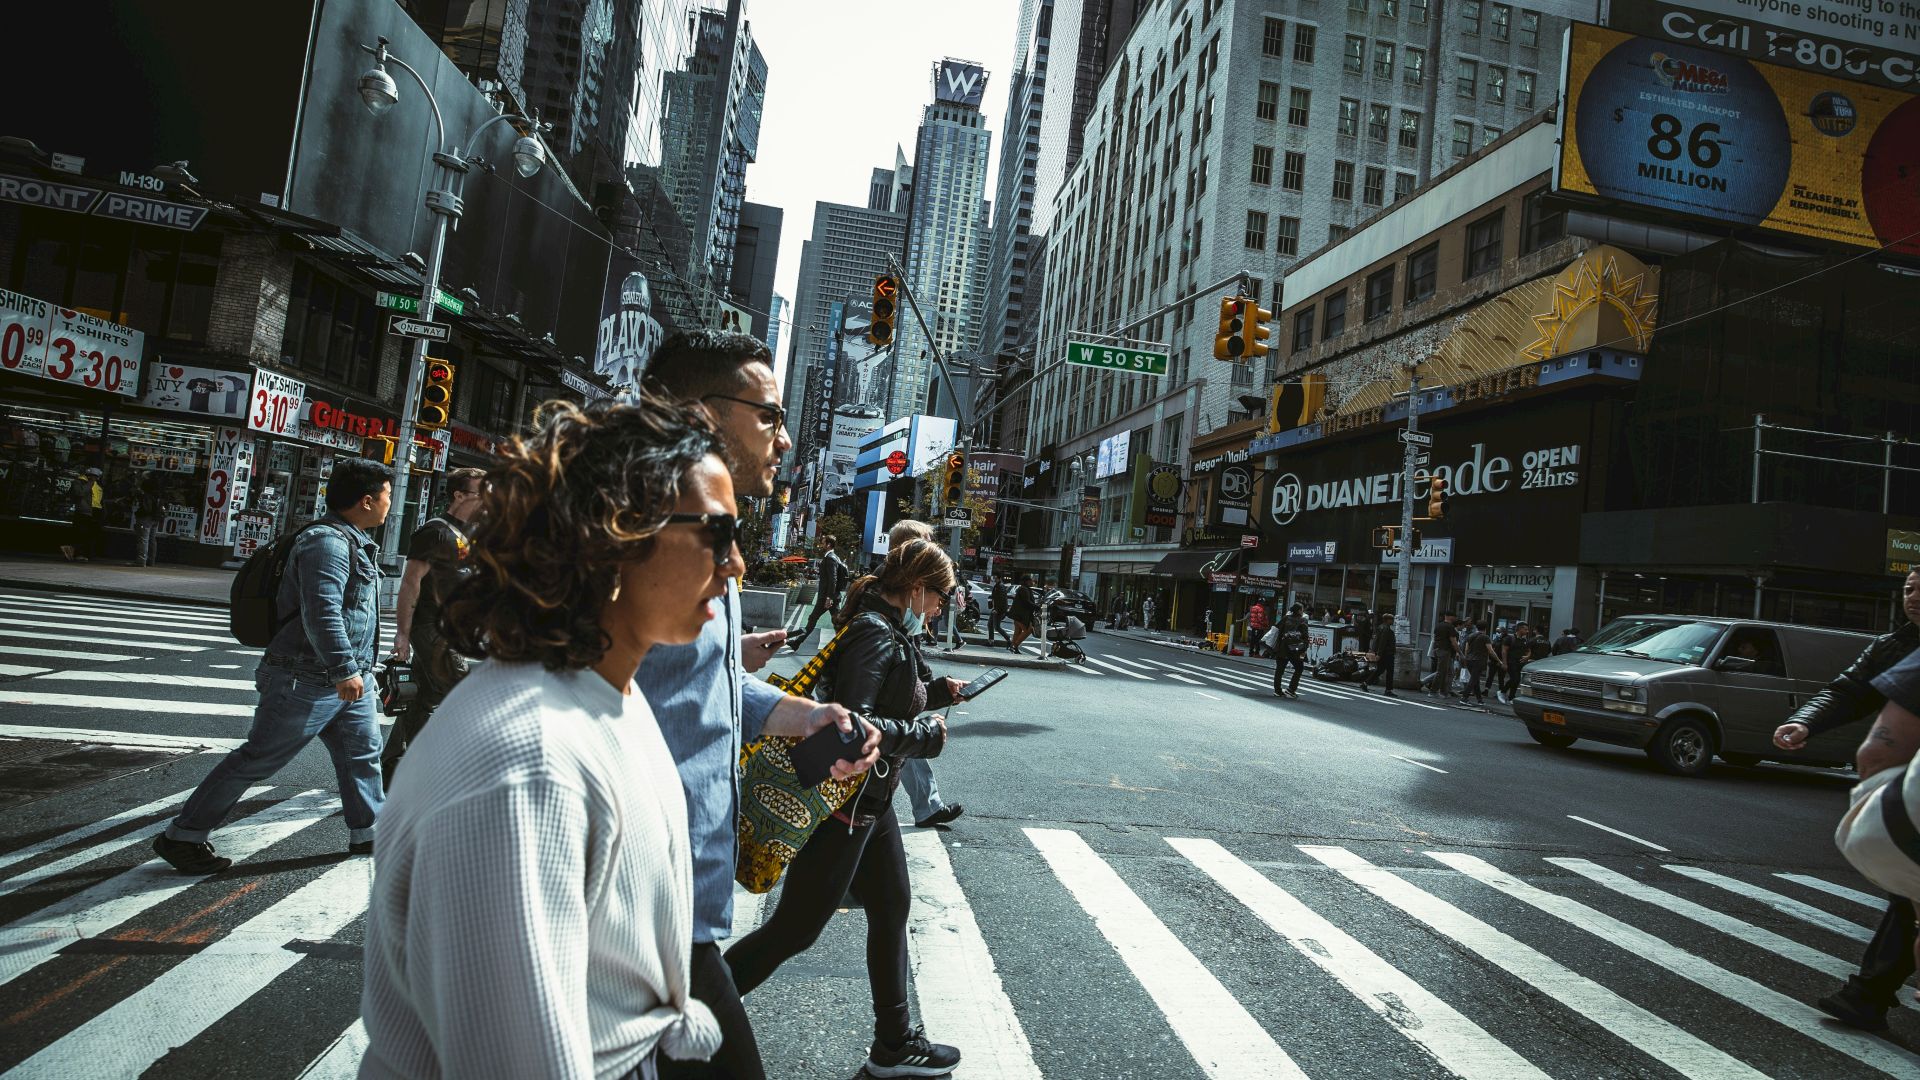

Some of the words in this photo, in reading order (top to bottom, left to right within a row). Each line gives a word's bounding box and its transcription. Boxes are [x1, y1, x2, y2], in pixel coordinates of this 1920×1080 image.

[1806, 3, 1884, 37] shooting
[1889, 23, 1899, 37] a
[1904, 23, 1920, 40] N
[1662, 11, 1750, 51] Call
[1766, 30, 1920, 84] 1-800-C
[945, 67, 980, 96] W
[1676, 60, 1729, 88] MEGA
[1639, 91, 1696, 110] ESTIMATED
[1696, 104, 1742, 119] JACKPOT
[1647, 113, 1723, 169] 86
[119, 170, 164, 192] M-130
[1637, 161, 1728, 193] MILLION
[0, 177, 89, 210] RONT
[107, 196, 195, 228] PRIME
[1789, 200, 1861, 220] RESPONSIBLY.
[1793, 189, 1833, 204] PLEASE
[1833, 195, 1859, 208] PLAY
[388, 294, 397, 307] W
[399, 298, 411, 310] 50
[26, 326, 45, 347] 99
[61, 320, 130, 348] T.SHIRTS
[79, 313, 105, 329] NEW
[106, 321, 135, 338] YORK
[399, 322, 420, 333] ONE
[423, 326, 442, 336] WAY
[47, 337, 76, 381] 3
[1080, 346, 1095, 362] W
[1102, 350, 1127, 366] 50
[1133, 354, 1156, 370] ST
[160, 365, 168, 378] I
[257, 371, 272, 387] NY
[154, 377, 185, 393] NY
[1452, 363, 1539, 404] CENTER
[253, 388, 269, 429] 3
[818, 367, 836, 433] SQUARE
[310, 399, 367, 437] GIFTS
[214, 440, 238, 456] NY
[1521, 443, 1581, 471] OPEN
[973, 459, 997, 472] hair
[1194, 456, 1224, 472] elegant
[1224, 449, 1249, 464] Nails
[206, 469, 229, 509] 3
[975, 488, 989, 496] walk
[989, 489, 996, 497] to
[1305, 472, 1390, 512] DUANE
[203, 508, 221, 538] 30
[240, 514, 270, 526] SALE
[244, 523, 262, 533] NY
[945, 518, 958, 527] BIKE
[957, 519, 970, 528] LANE
[1146, 513, 1176, 525] FOOD
[1289, 546, 1317, 558] pharmacy
[1892, 538, 1913, 551] Now
[1481, 570, 1555, 591] pharmacy
